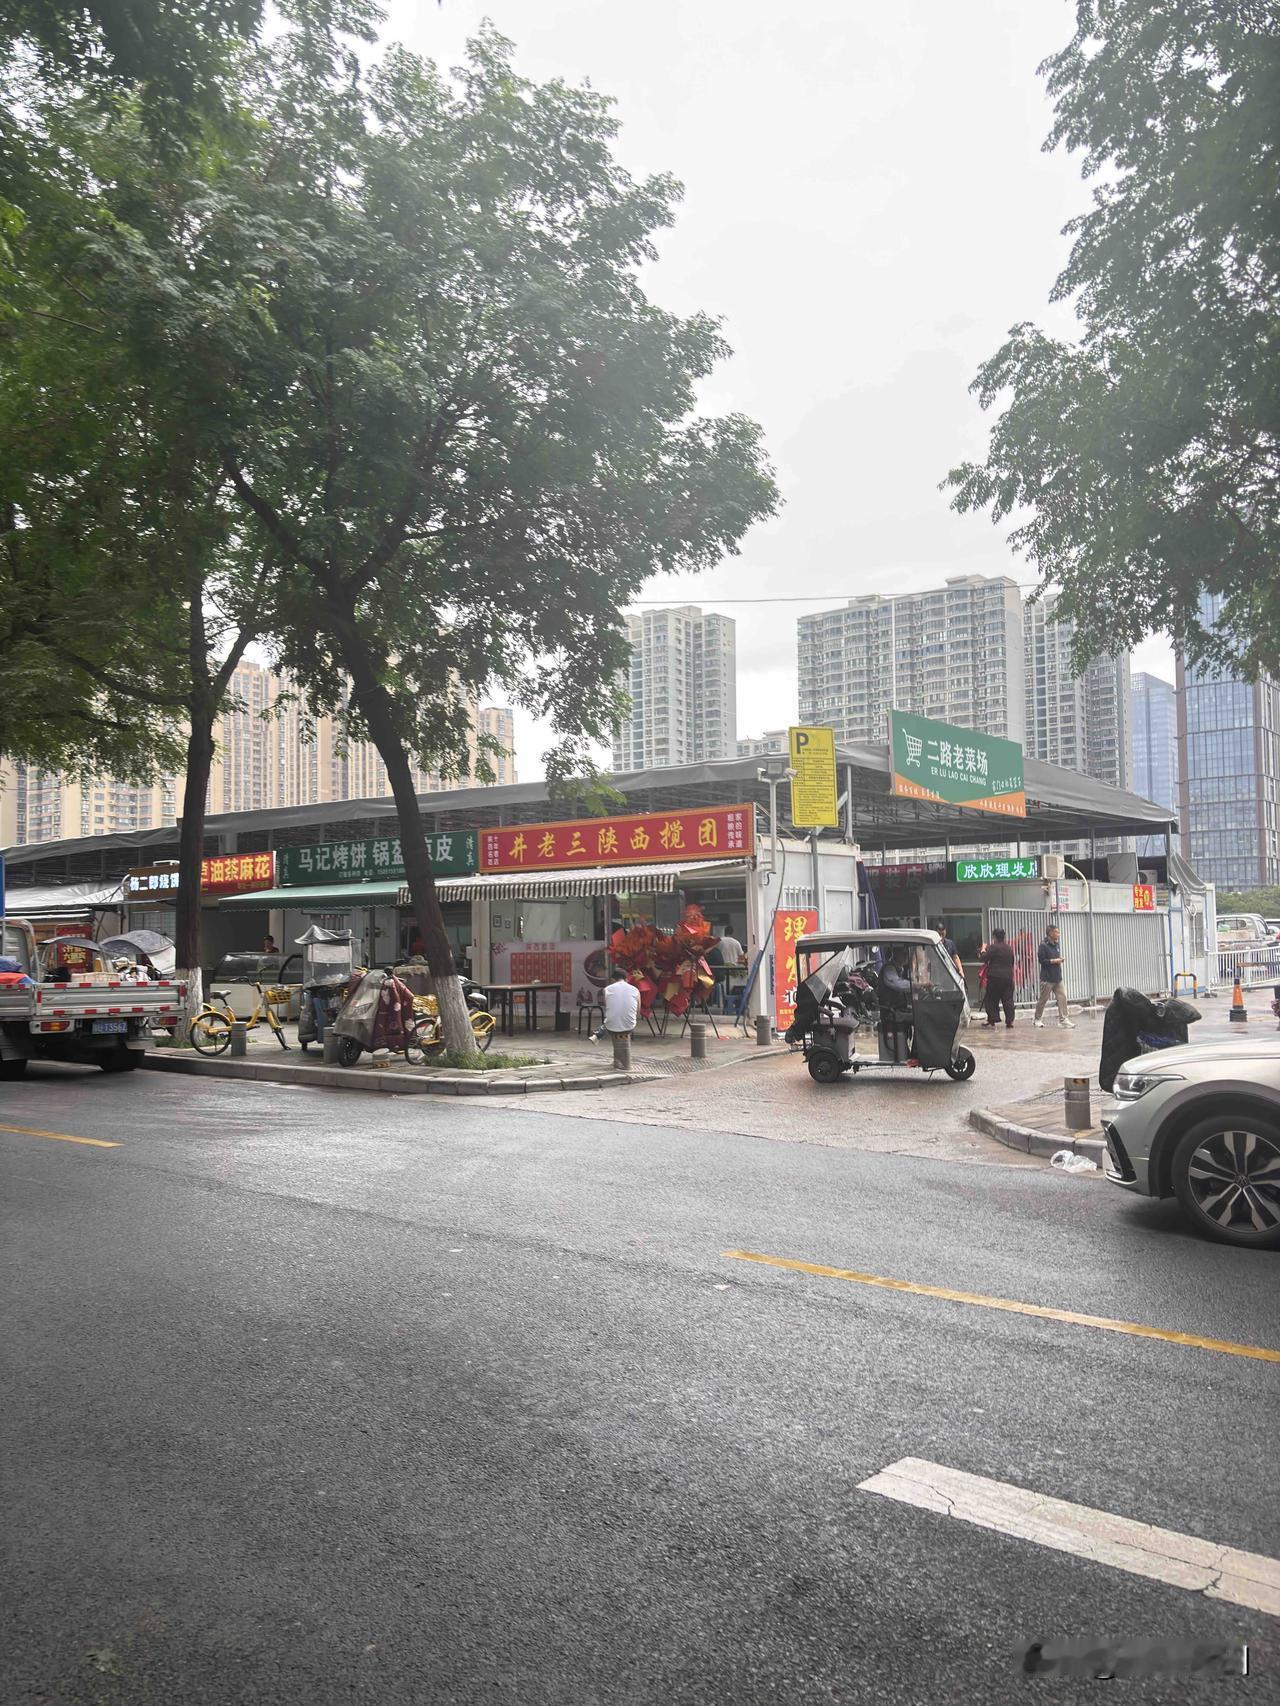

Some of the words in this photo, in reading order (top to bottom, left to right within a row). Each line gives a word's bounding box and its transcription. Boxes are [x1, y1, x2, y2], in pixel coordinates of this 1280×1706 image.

[796, 732, 809, 754] P
[928, 740, 988, 776] 二路老菜场
[931, 766, 938, 776] ER
[940, 768, 947, 778] LU
[948, 770, 959, 780] LAO
[960, 772, 969, 782] CAI
[969, 774, 987, 786] CHANG
[298, 847, 367, 872] 马记烤饼
